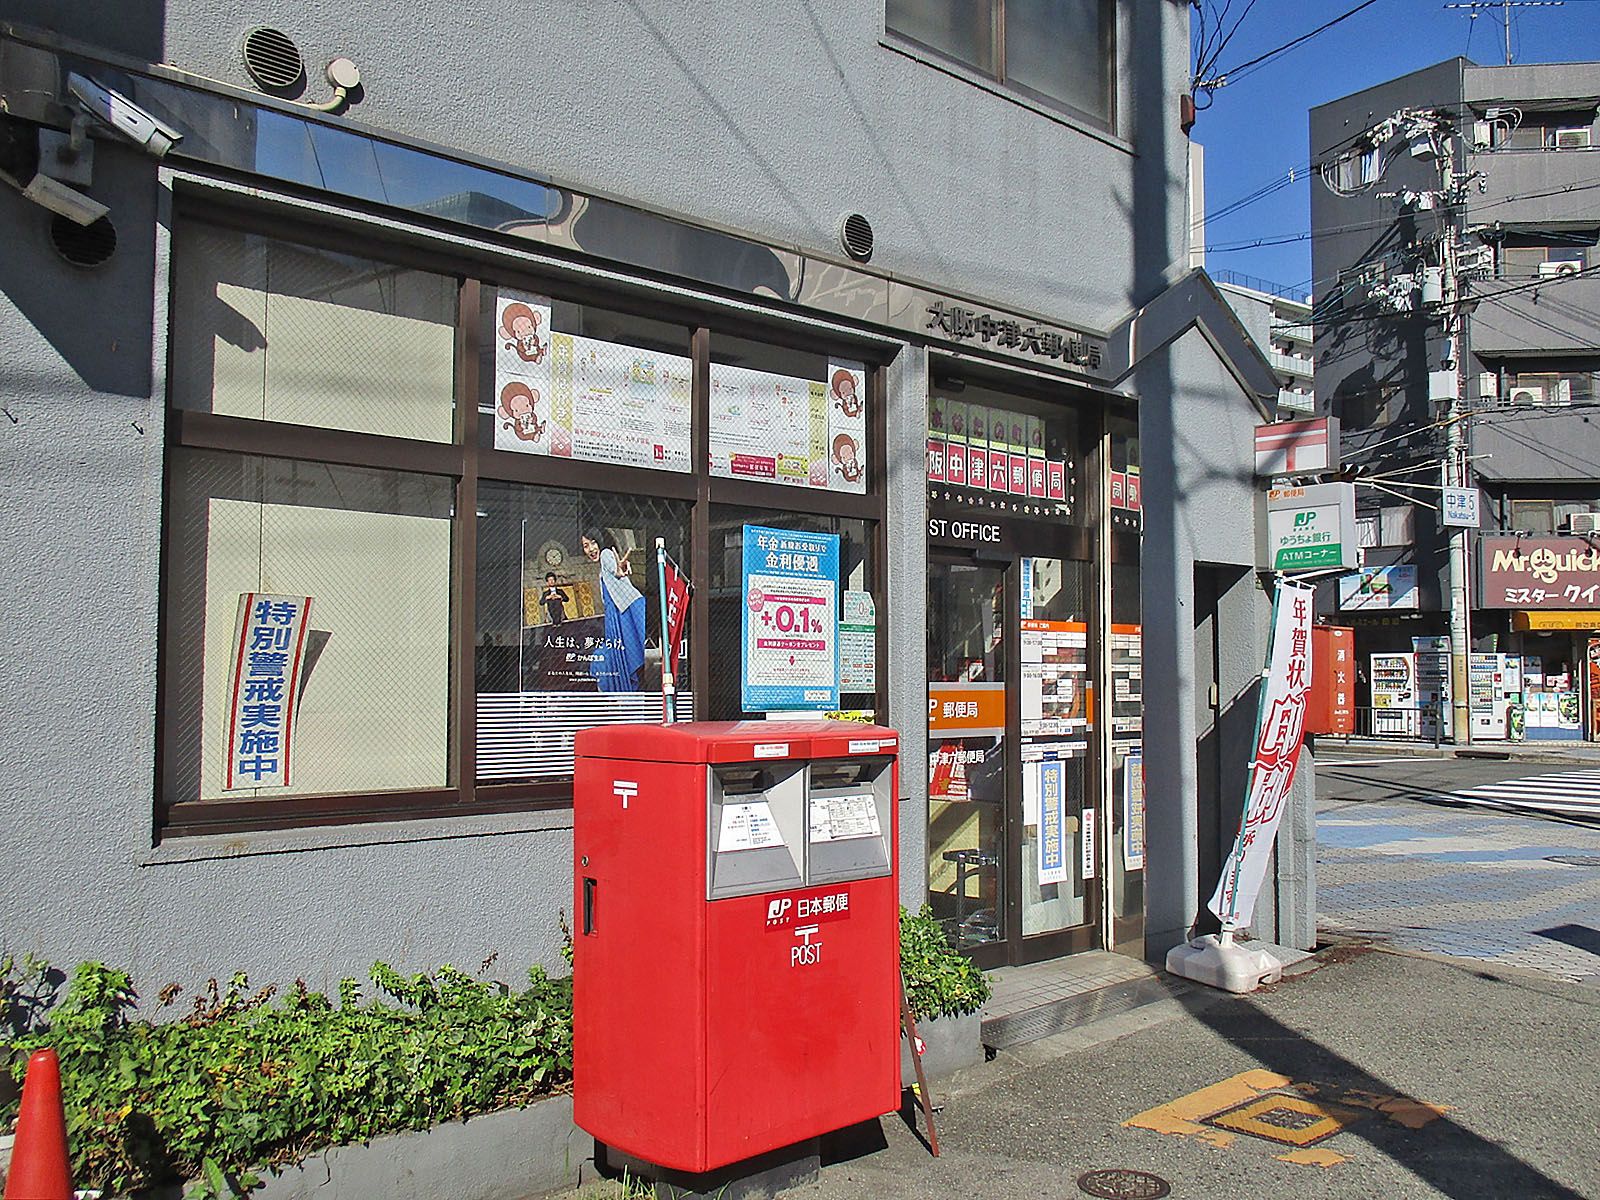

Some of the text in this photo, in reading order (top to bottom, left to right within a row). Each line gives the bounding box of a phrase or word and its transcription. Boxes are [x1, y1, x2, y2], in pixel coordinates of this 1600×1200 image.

[926, 301, 1103, 369] 大阪中津六郵便局
[929, 449, 1062, 491] 阪中津六郵便局
[951, 522, 1001, 542] OFFICE
[1280, 531, 1331, 546] ゆうちょ銀行
[765, 551, 819, 572] 金利優遇
[1282, 549, 1337, 560] ATMコーナー
[238, 600, 297, 781] 特別警戒実施中
[943, 701, 978, 719] 郵便局
[1044, 768, 1060, 868] 特別警戒実施中
[797, 893, 849, 918] 日本郵便
[766, 917, 790, 926] POST
[791, 942, 823, 967] POST
